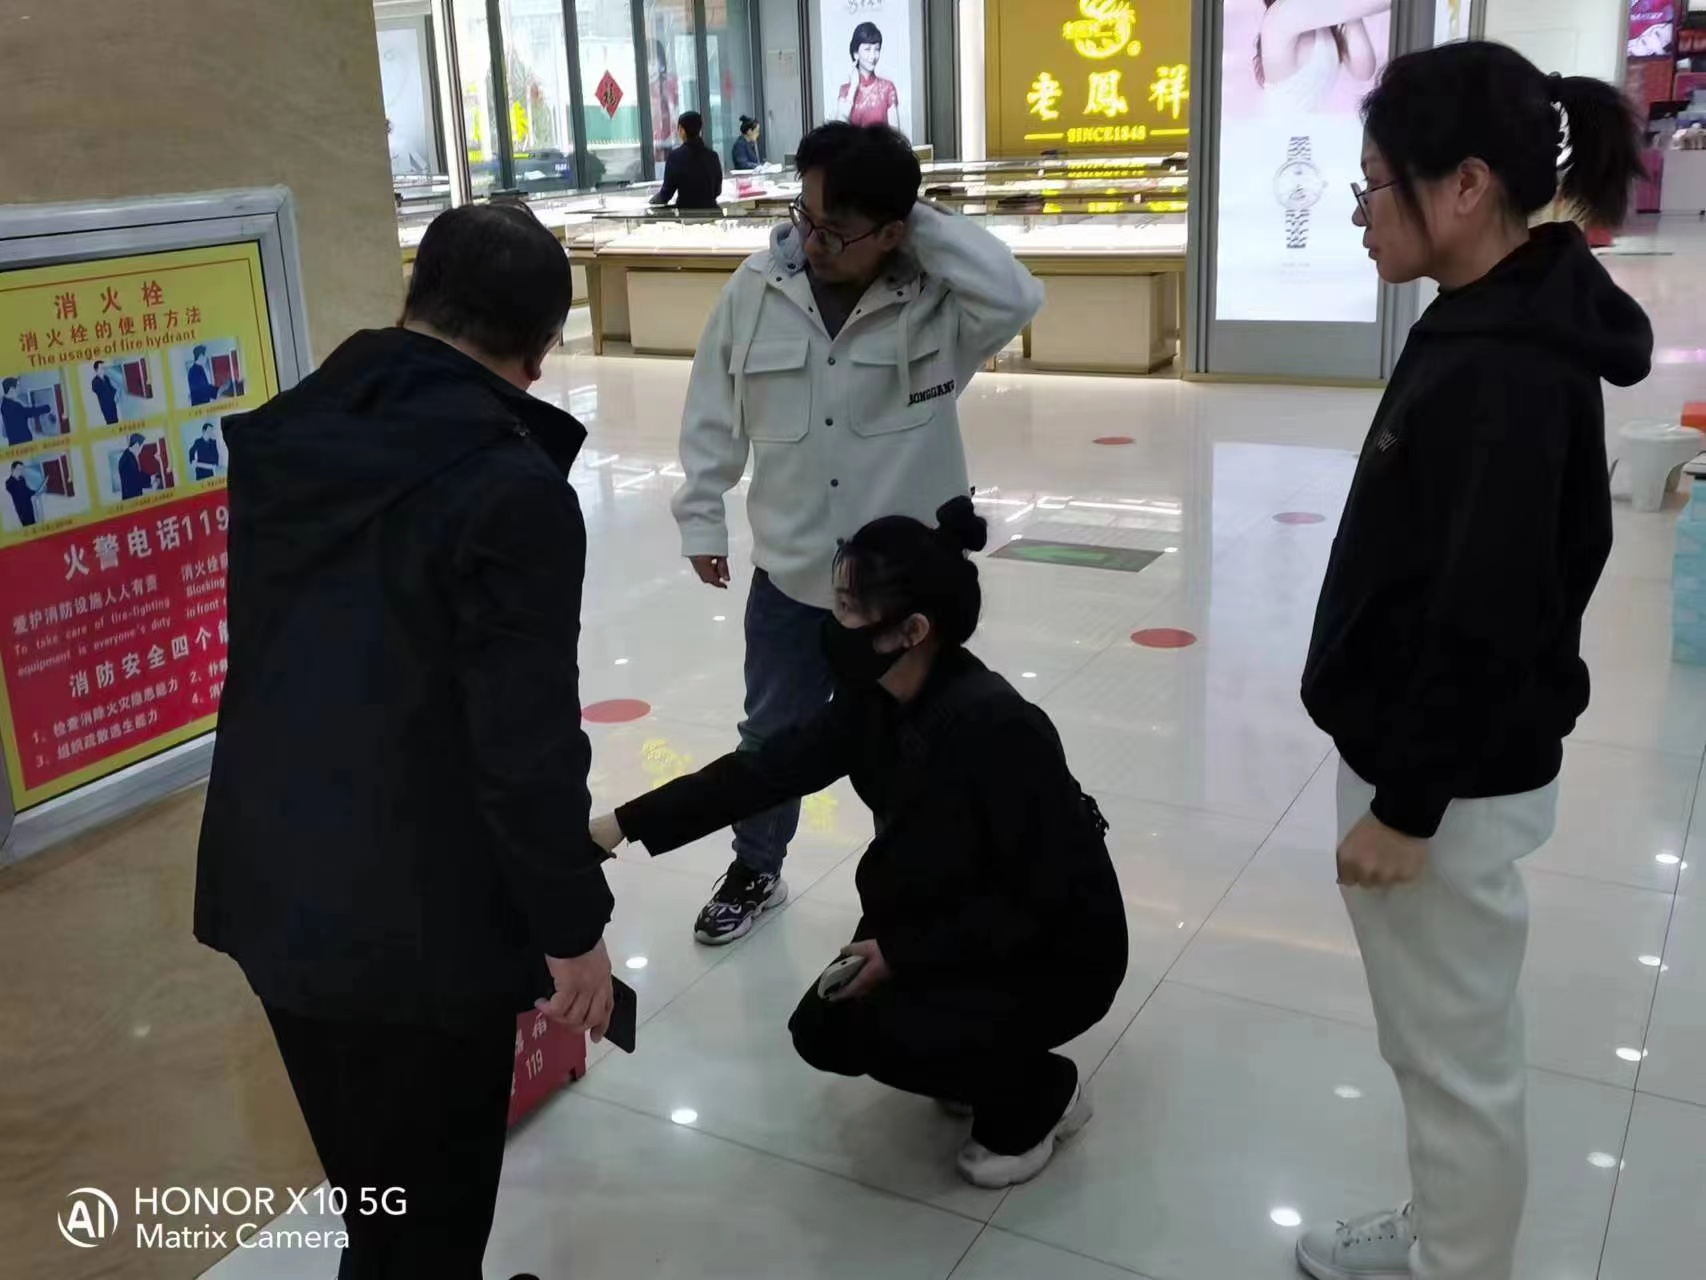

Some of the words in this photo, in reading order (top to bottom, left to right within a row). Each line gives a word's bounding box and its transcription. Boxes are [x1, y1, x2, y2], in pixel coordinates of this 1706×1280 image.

[1026, 63, 1190, 121] 老鳳祥
[54, 280, 165, 320] 消火栓
[19, 306, 202, 353] 消火栓的使用方法
[28, 354, 56, 368] The
[58, 347, 101, 362] usage
[104, 340, 117, 353] of
[119, 336, 143, 351] fire
[145, 329, 197, 348] hydrant
[63, 505, 229, 580] 火警电话119
[525, 1048, 543, 1080] 119
